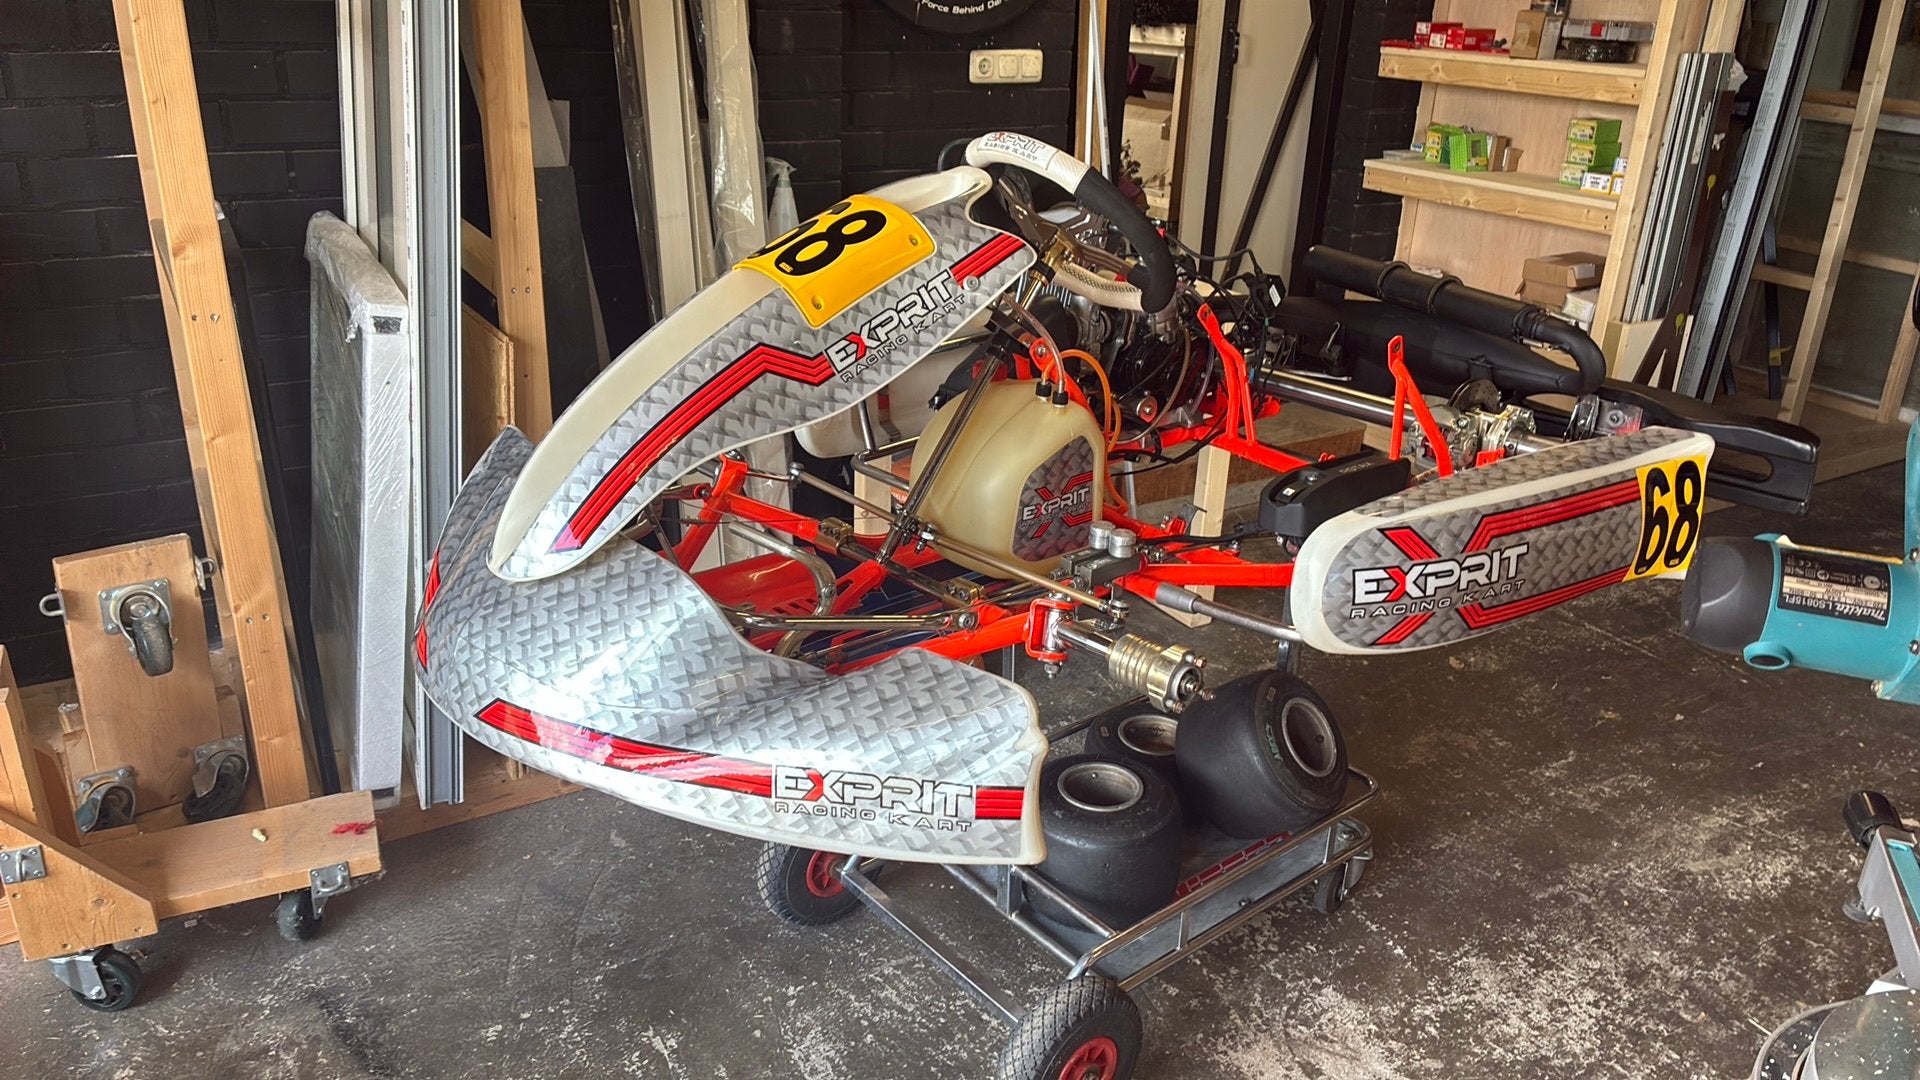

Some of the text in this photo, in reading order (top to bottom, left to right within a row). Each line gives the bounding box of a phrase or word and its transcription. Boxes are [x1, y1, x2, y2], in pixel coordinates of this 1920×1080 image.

[952, 4, 984, 14] Behind
[986, 132, 1046, 154] EXPRIT
[824, 269, 952, 373] EXPRIT
[840, 294, 965, 383] RACING KART
[1021, 487, 1090, 521] EXPRIT
[1634, 460, 1702, 575] 68
[1352, 542, 1530, 606] EXPRIT
[1350, 579, 1525, 619] RACING KART
[774, 765, 973, 818] EXPRIT
[774, 801, 973, 833] RACING KART
